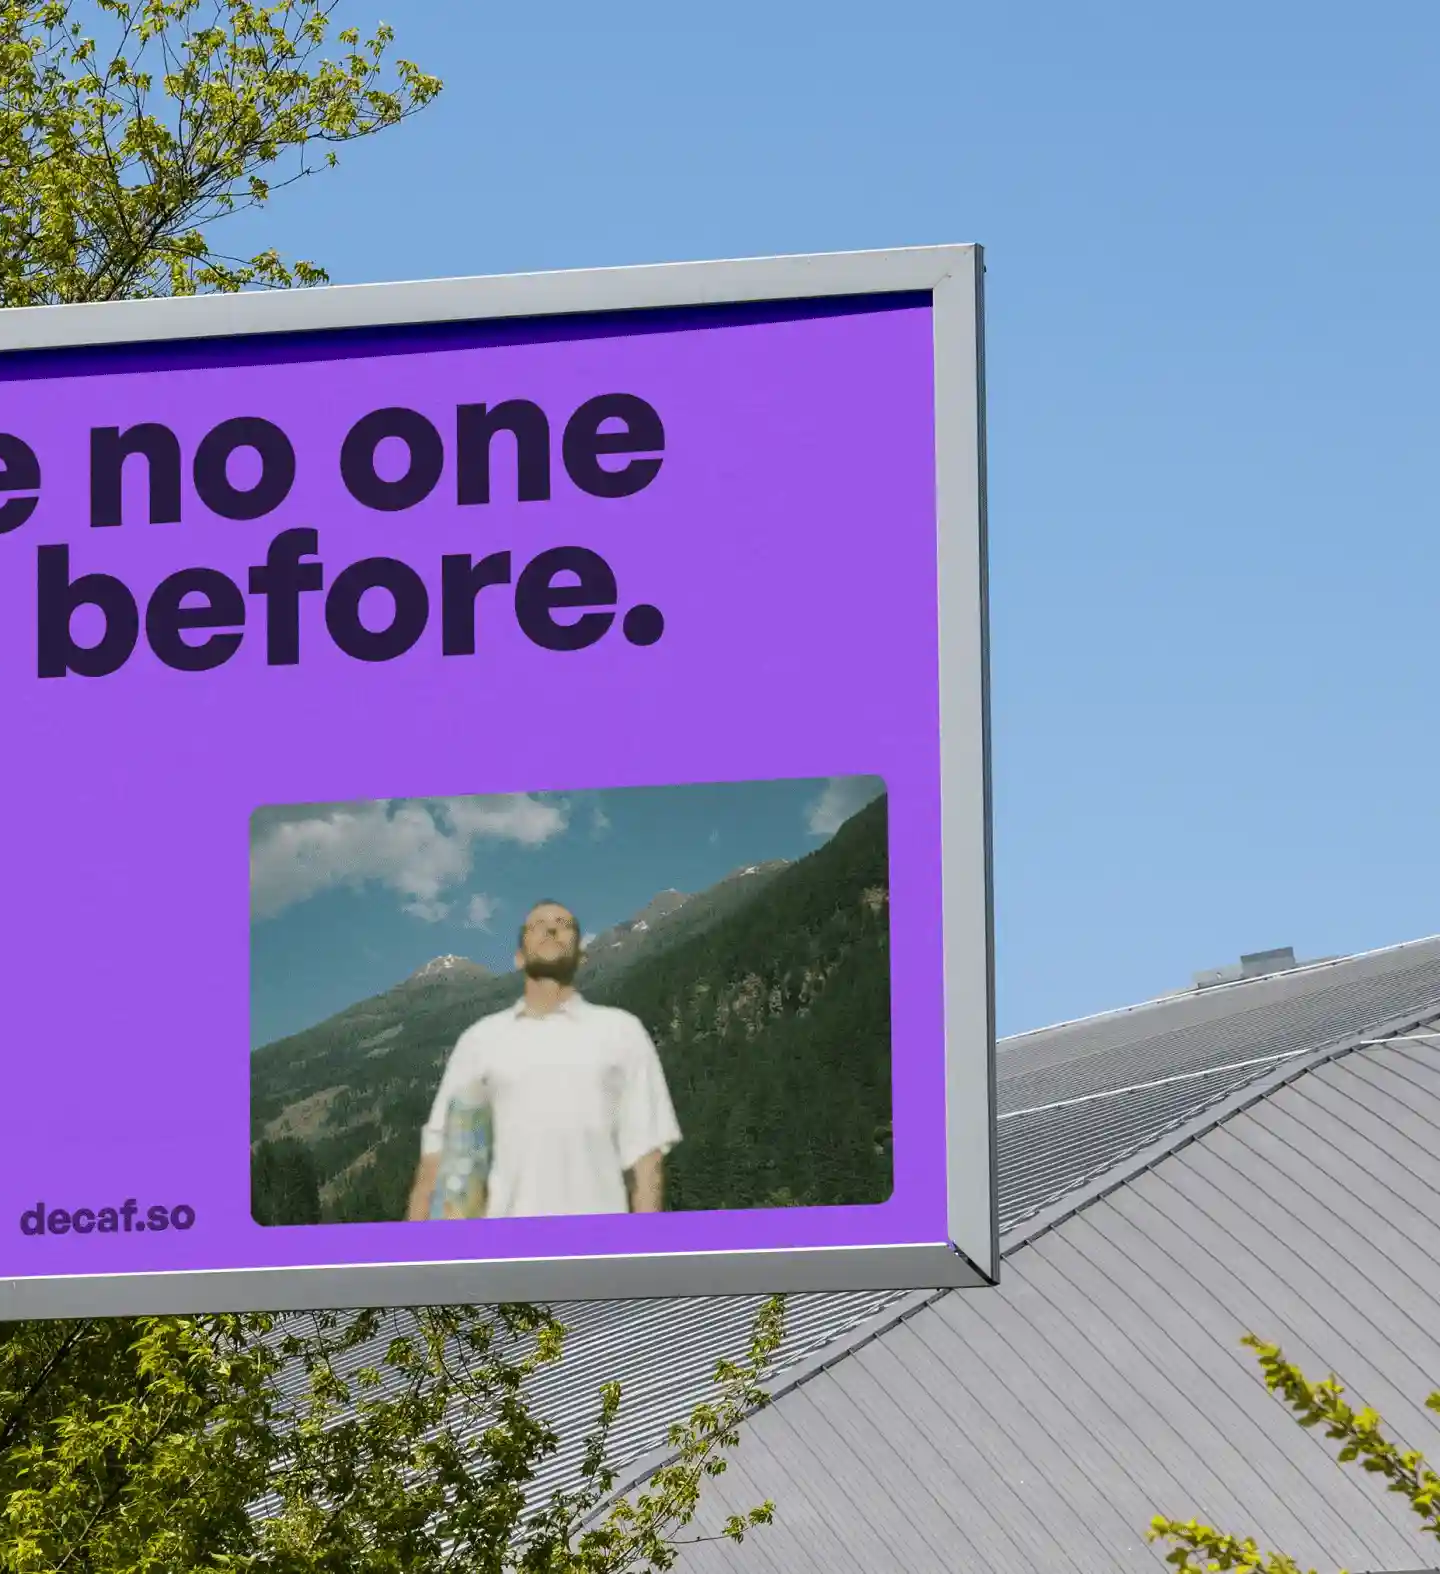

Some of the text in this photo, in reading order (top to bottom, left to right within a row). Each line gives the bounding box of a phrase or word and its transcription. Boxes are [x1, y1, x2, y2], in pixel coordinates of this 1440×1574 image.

[89, 416, 296, 528] no
[339, 392, 666, 512] one
[37, 527, 665, 679] before.
[20, 1198, 196, 1236] decaf.so
